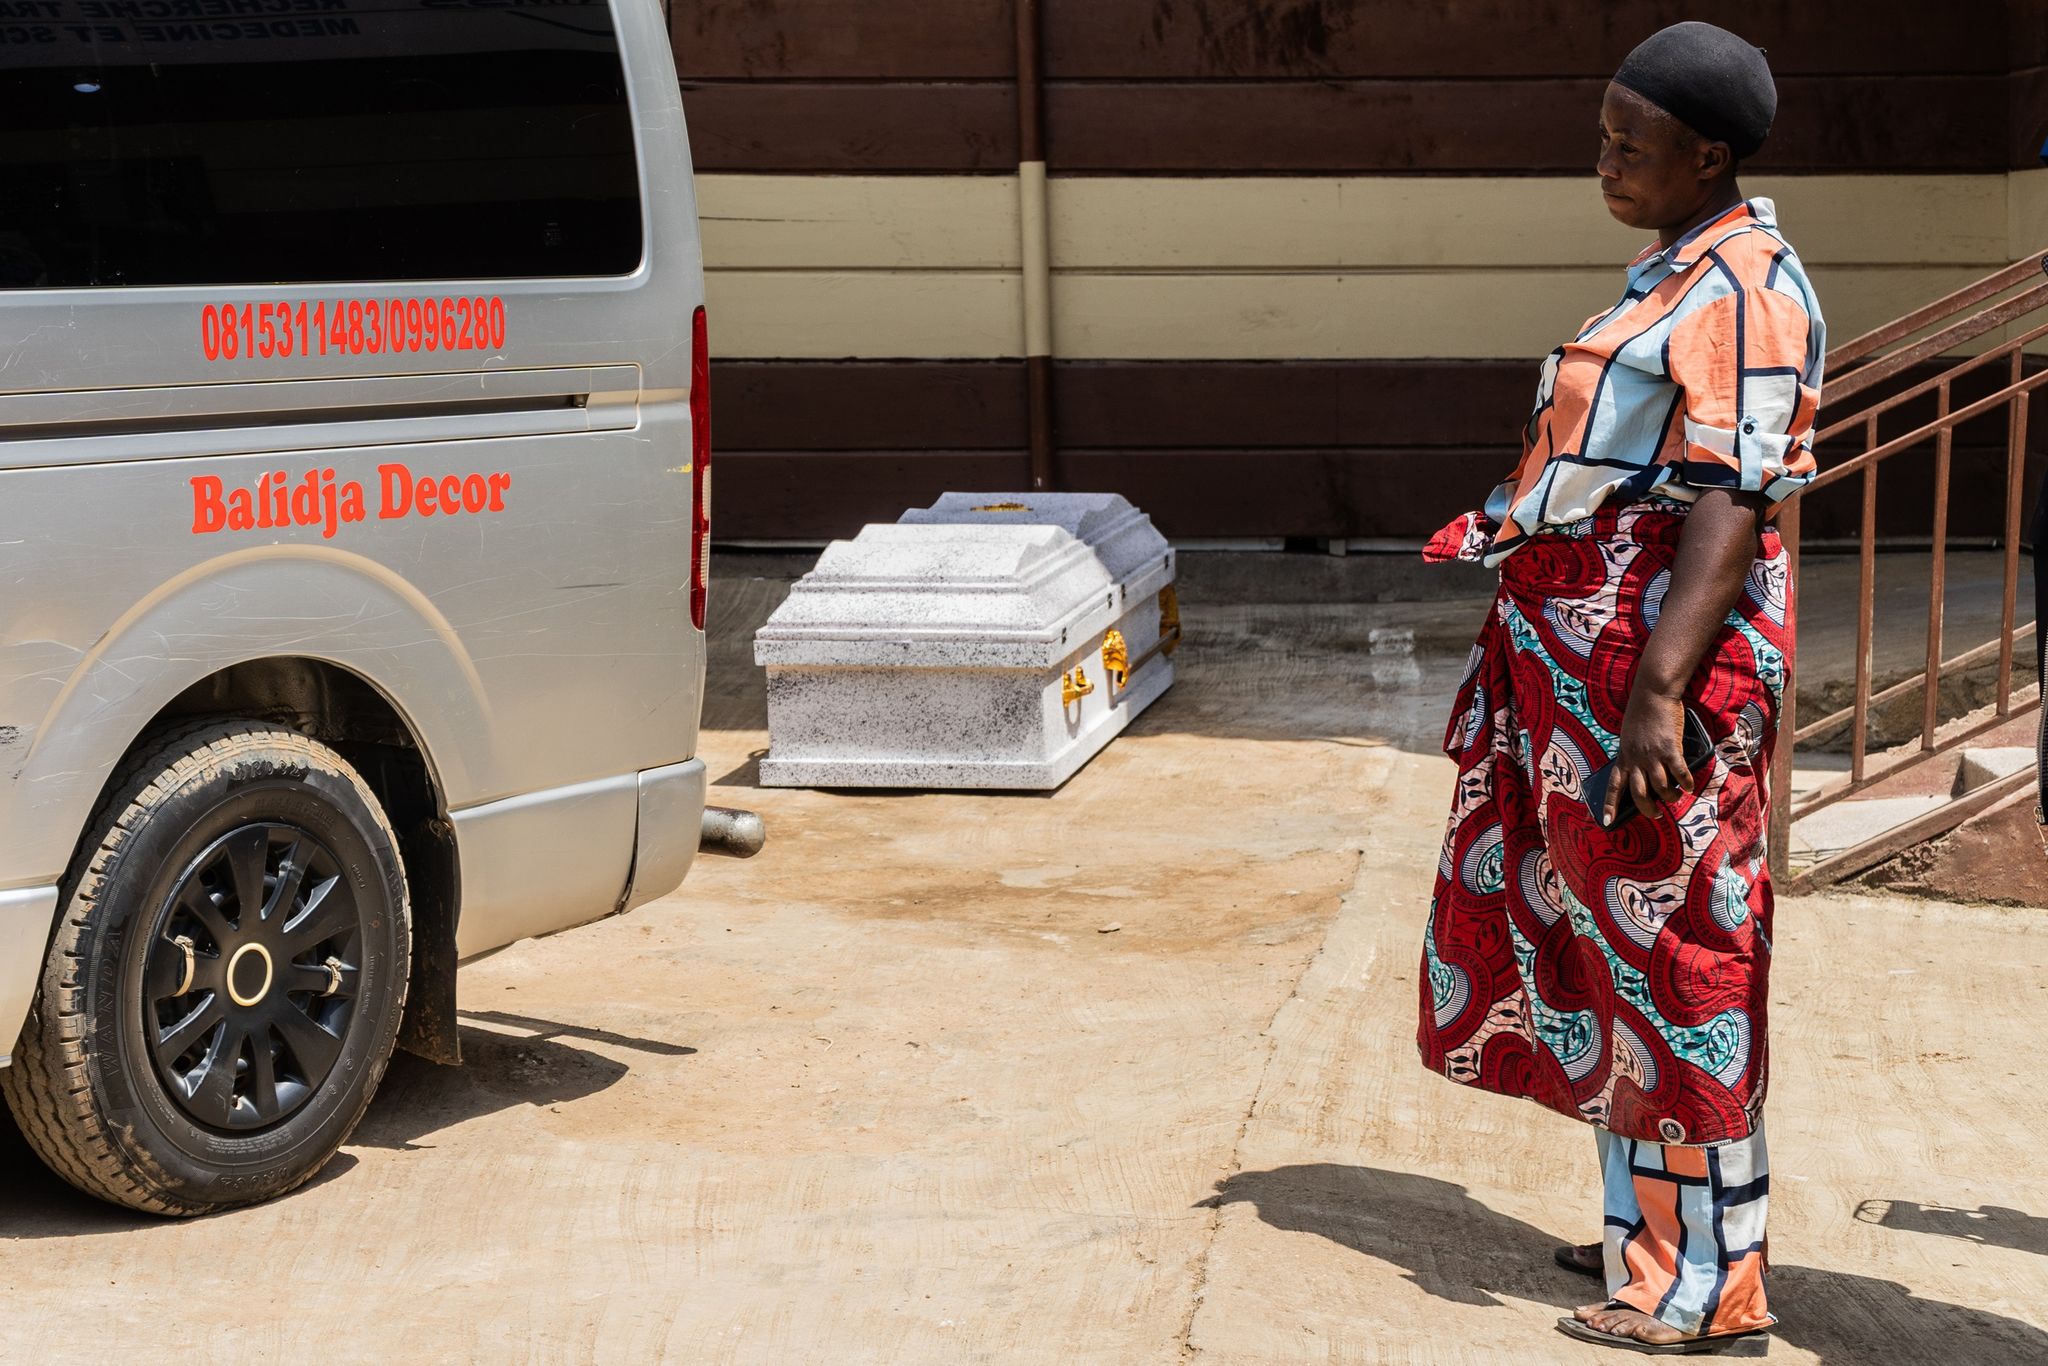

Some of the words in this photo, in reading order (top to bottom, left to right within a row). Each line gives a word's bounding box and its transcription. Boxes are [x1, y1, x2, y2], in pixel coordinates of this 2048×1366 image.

[202, 297, 505, 361] 0815311483/0996280
[190, 468, 366, 539] Balidja
[377, 463, 511, 520] Decor
